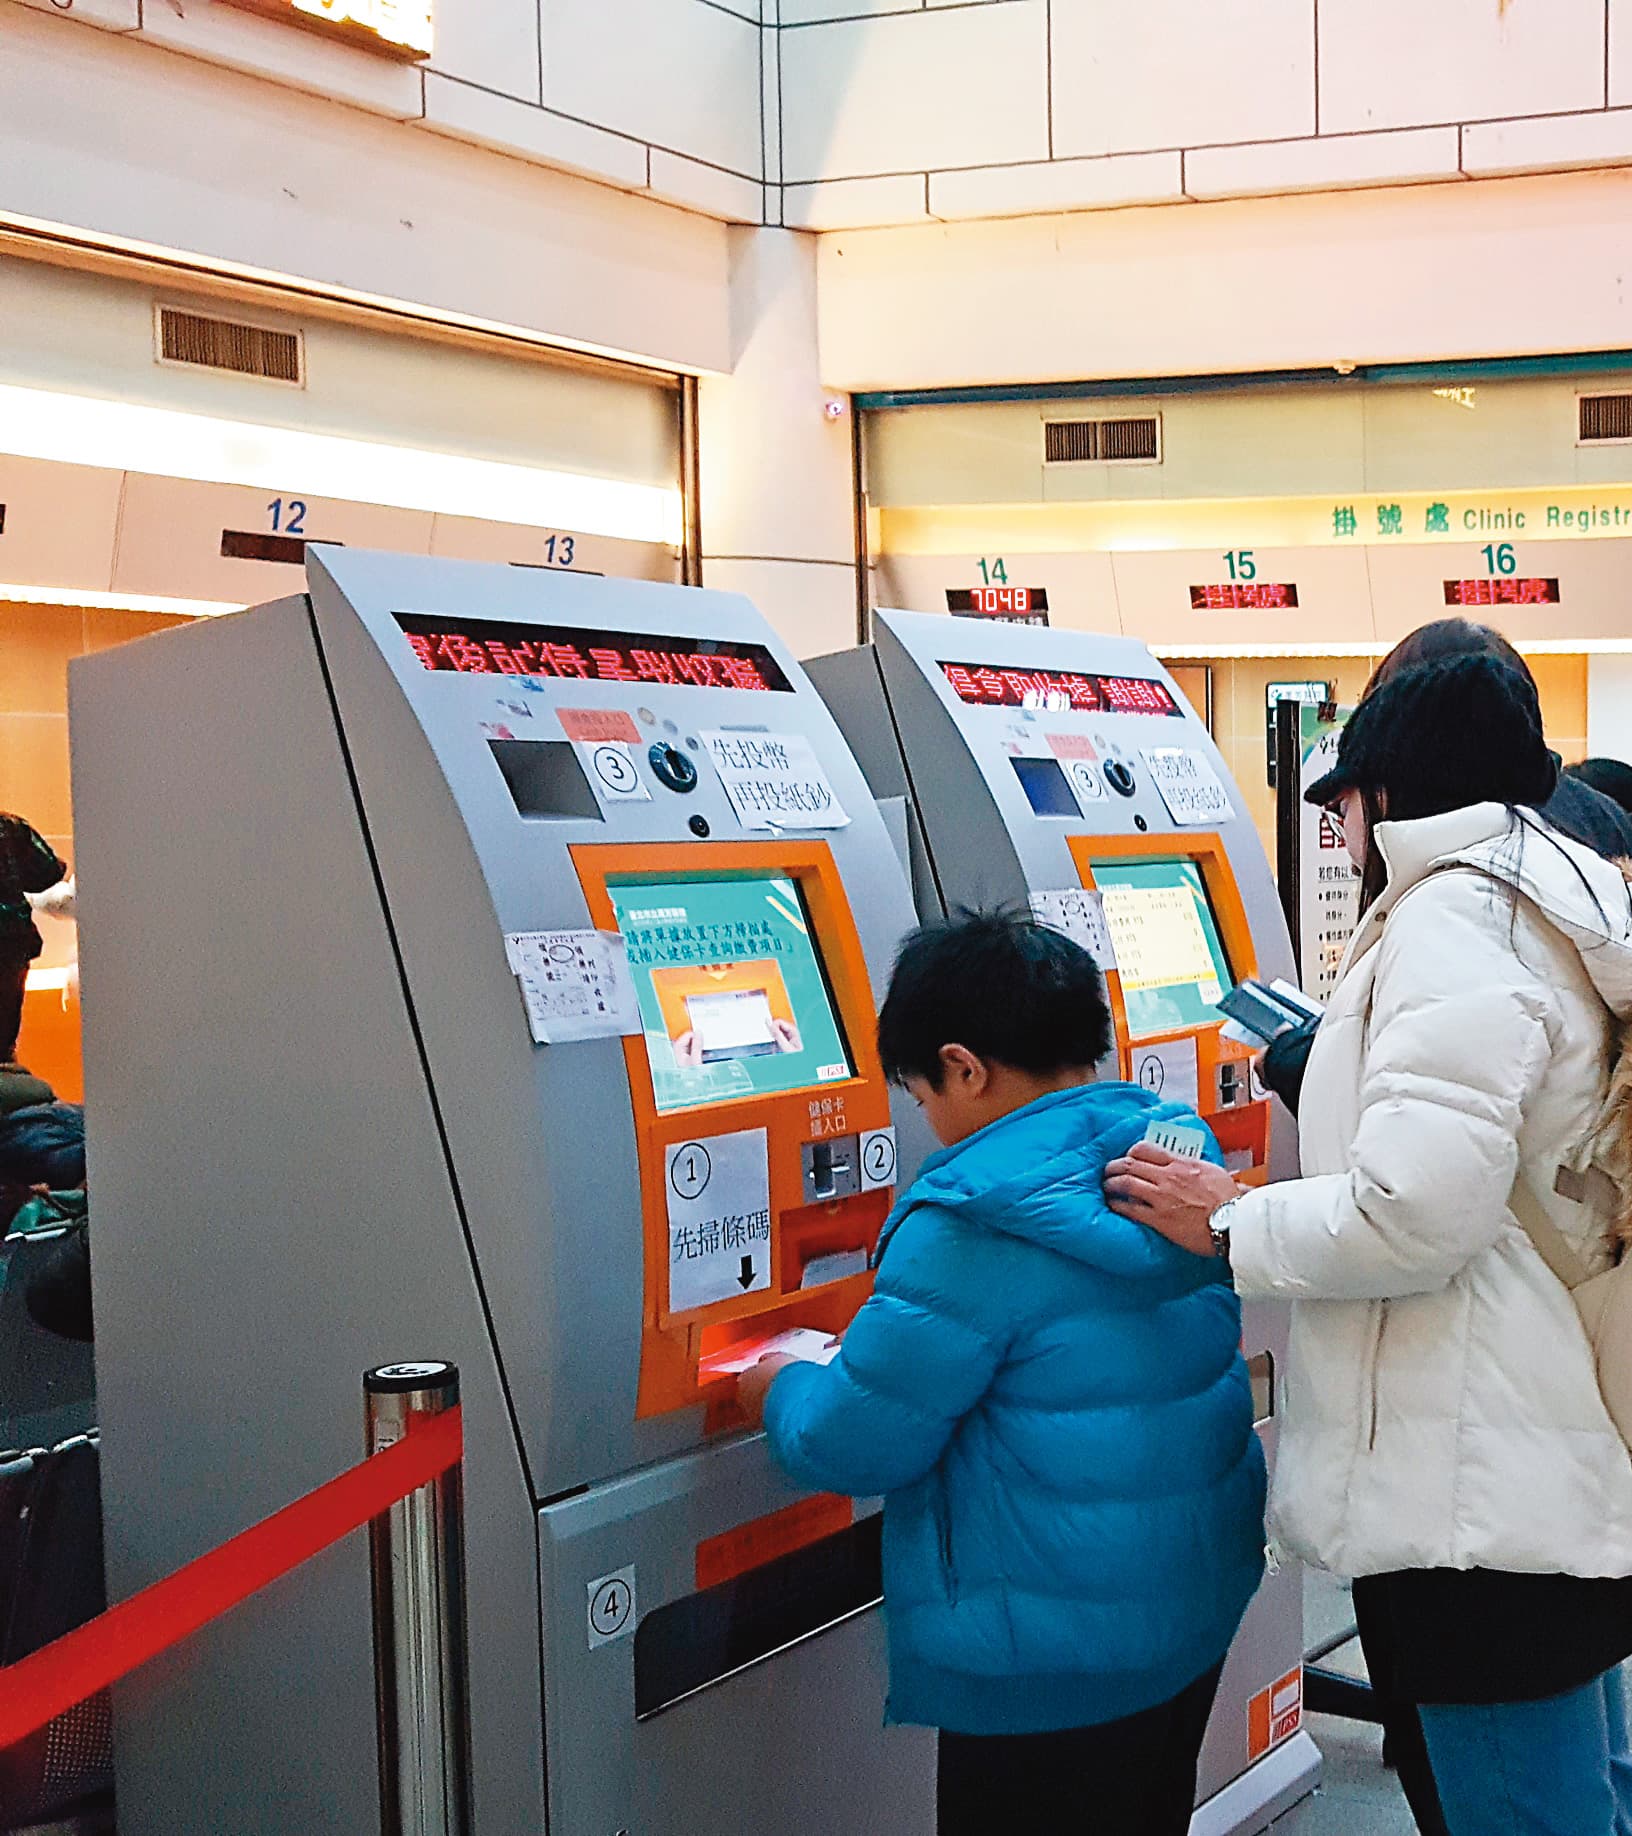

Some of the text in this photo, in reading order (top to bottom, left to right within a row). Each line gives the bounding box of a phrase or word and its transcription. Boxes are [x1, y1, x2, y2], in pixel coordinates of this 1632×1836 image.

[266, 499, 308, 534] 12
[1332, 502, 1450, 536] 掛號處
[1463, 506, 1527, 531] Clinic
[543, 535, 576, 567] 13
[1222, 550, 1256, 580] 15
[1480, 543, 1516, 575] 16
[976, 557, 1008, 586] 14
[971, 587, 1027, 611] 7048
[713, 739, 790, 770] 先投幣
[726, 781, 831, 812] 再投紙鈔
[809, 1096, 845, 1119] 健保卡
[672, 1208, 770, 1264] 先掃條碼
